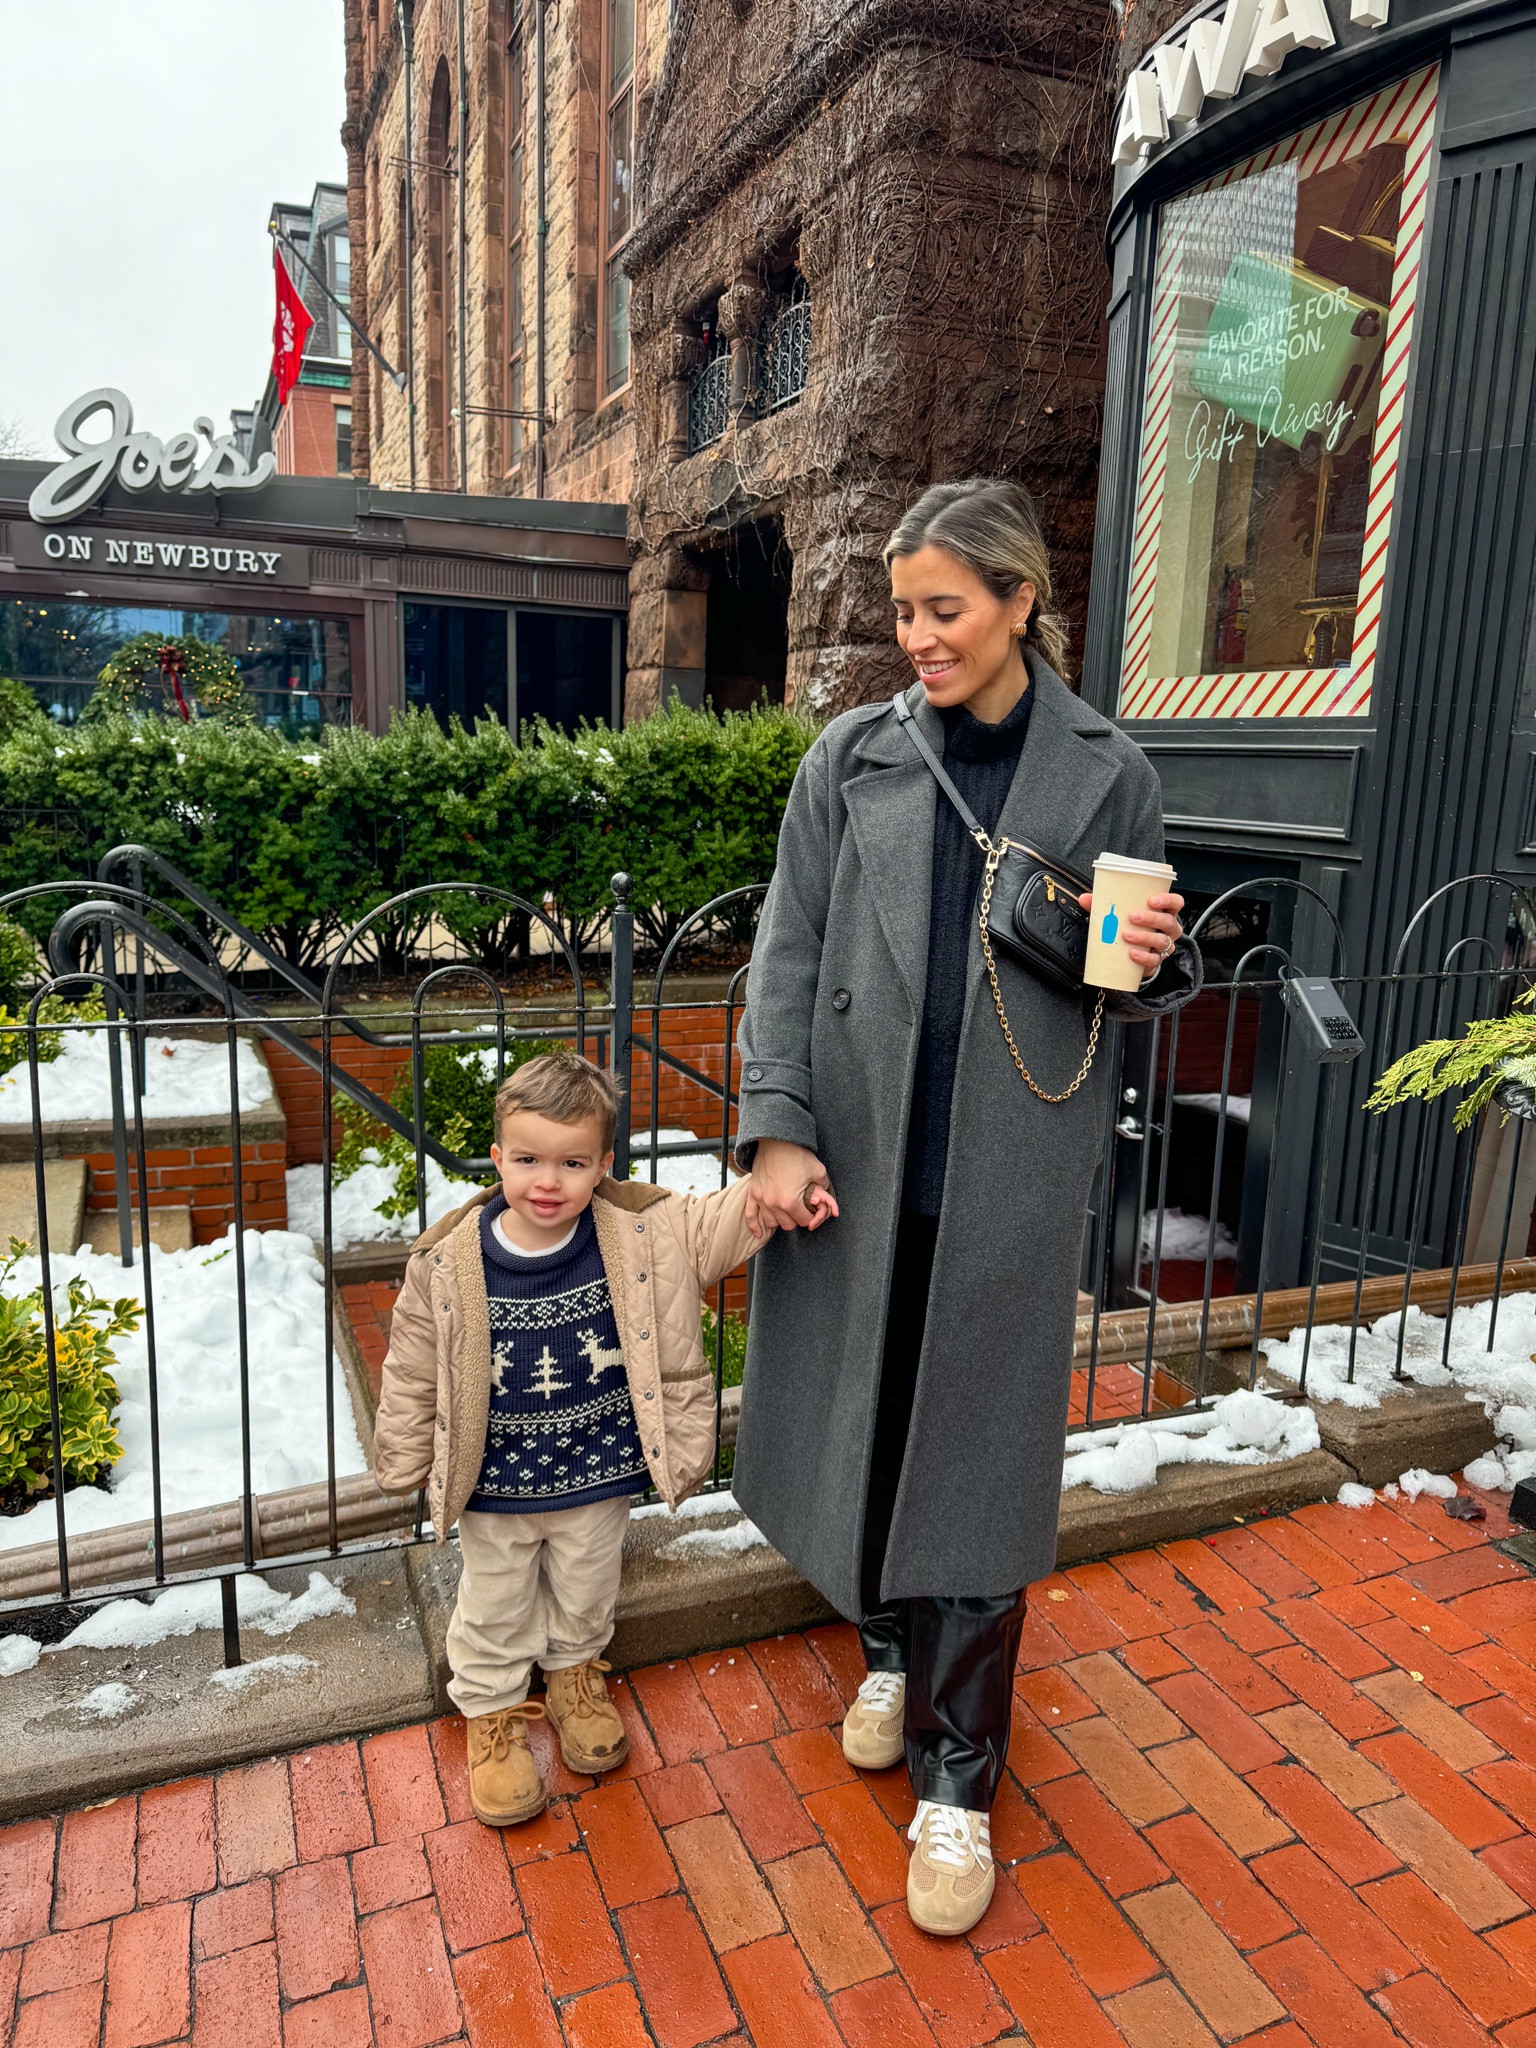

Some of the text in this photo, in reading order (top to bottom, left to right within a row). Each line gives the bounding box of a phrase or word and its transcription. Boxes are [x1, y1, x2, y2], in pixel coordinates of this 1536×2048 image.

[1111, 0, 1389, 166] AWA
[1208, 286, 1350, 359] FAVORITE FOR
[1219, 326, 1326, 384] A REASON.
[28, 387, 276, 524] Joe's
[1184, 385, 1358, 484] Gift Away.
[43, 533, 282, 576] ON NEWBURY
